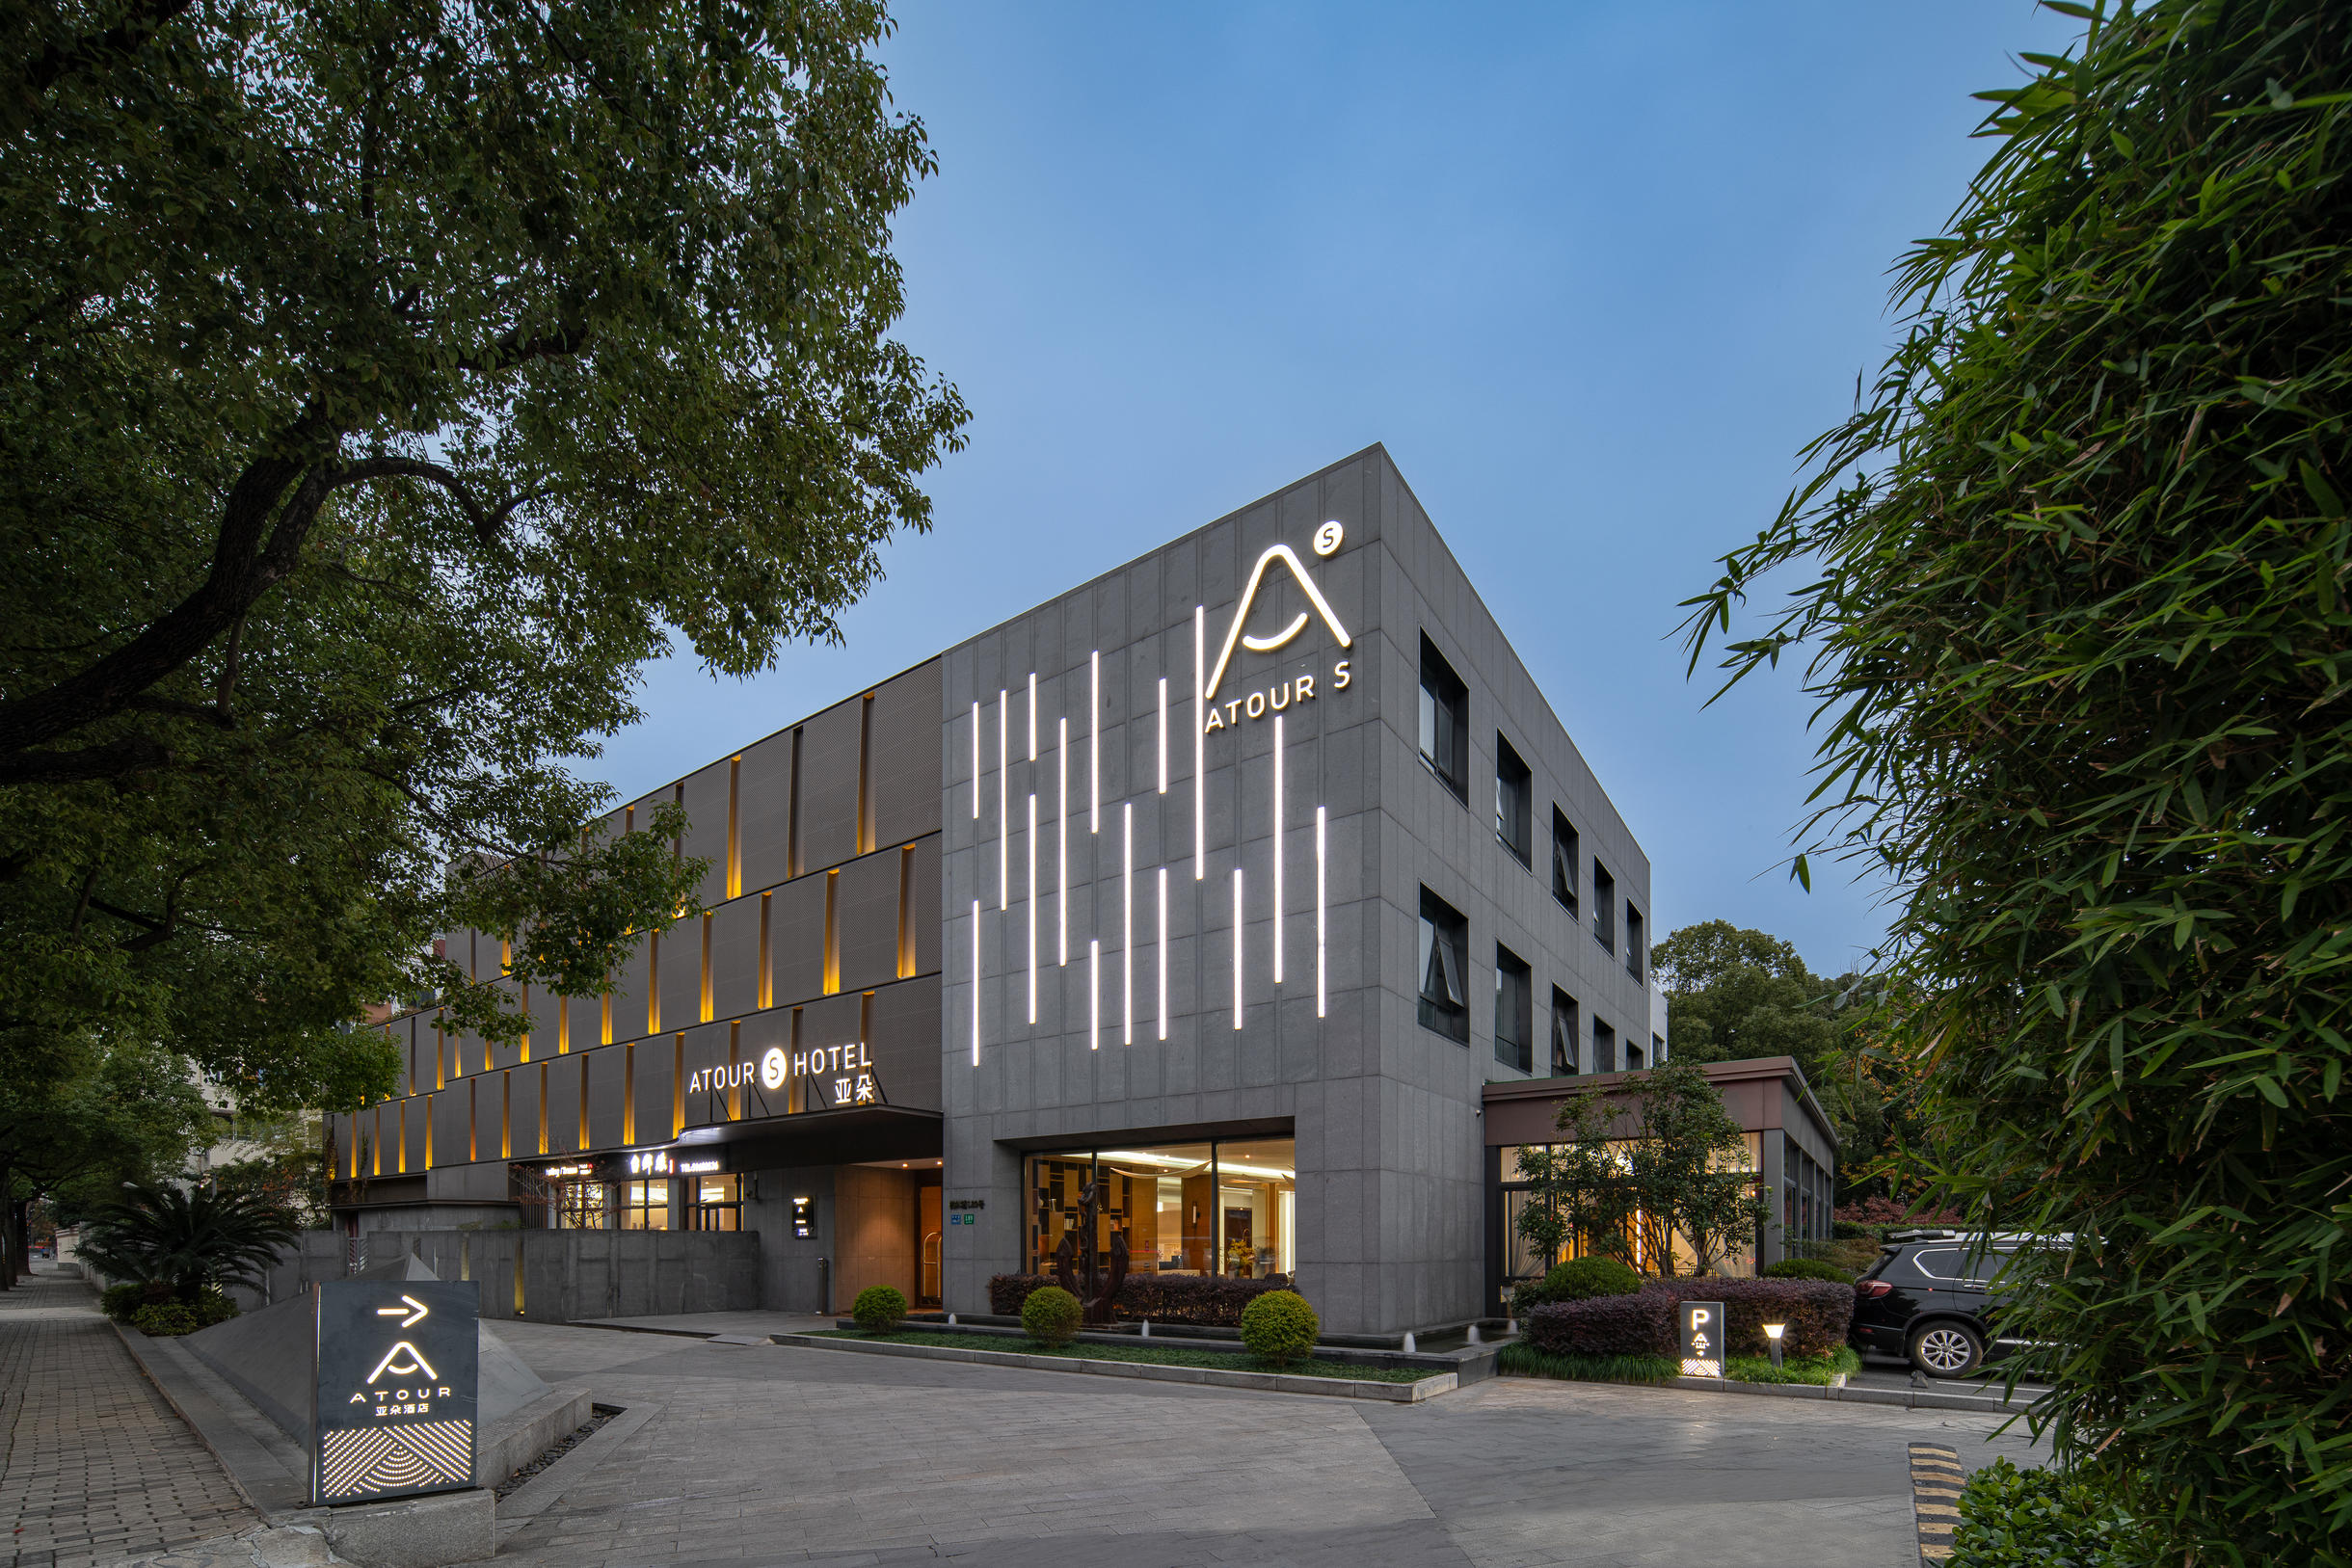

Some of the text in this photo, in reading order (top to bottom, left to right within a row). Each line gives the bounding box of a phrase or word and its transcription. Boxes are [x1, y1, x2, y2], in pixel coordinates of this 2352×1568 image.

[1204, 660, 1351, 733] ATOUR S
[688, 1061, 756, 1094] ATOUR
[793, 1042, 872, 1076] HOTEL
[835, 1074, 874, 1104] 亚朵
[1692, 1309, 1711, 1331] P
[349, 1386, 452, 1404] ATOUR
[375, 1403, 430, 1417] 亚朵酒店
